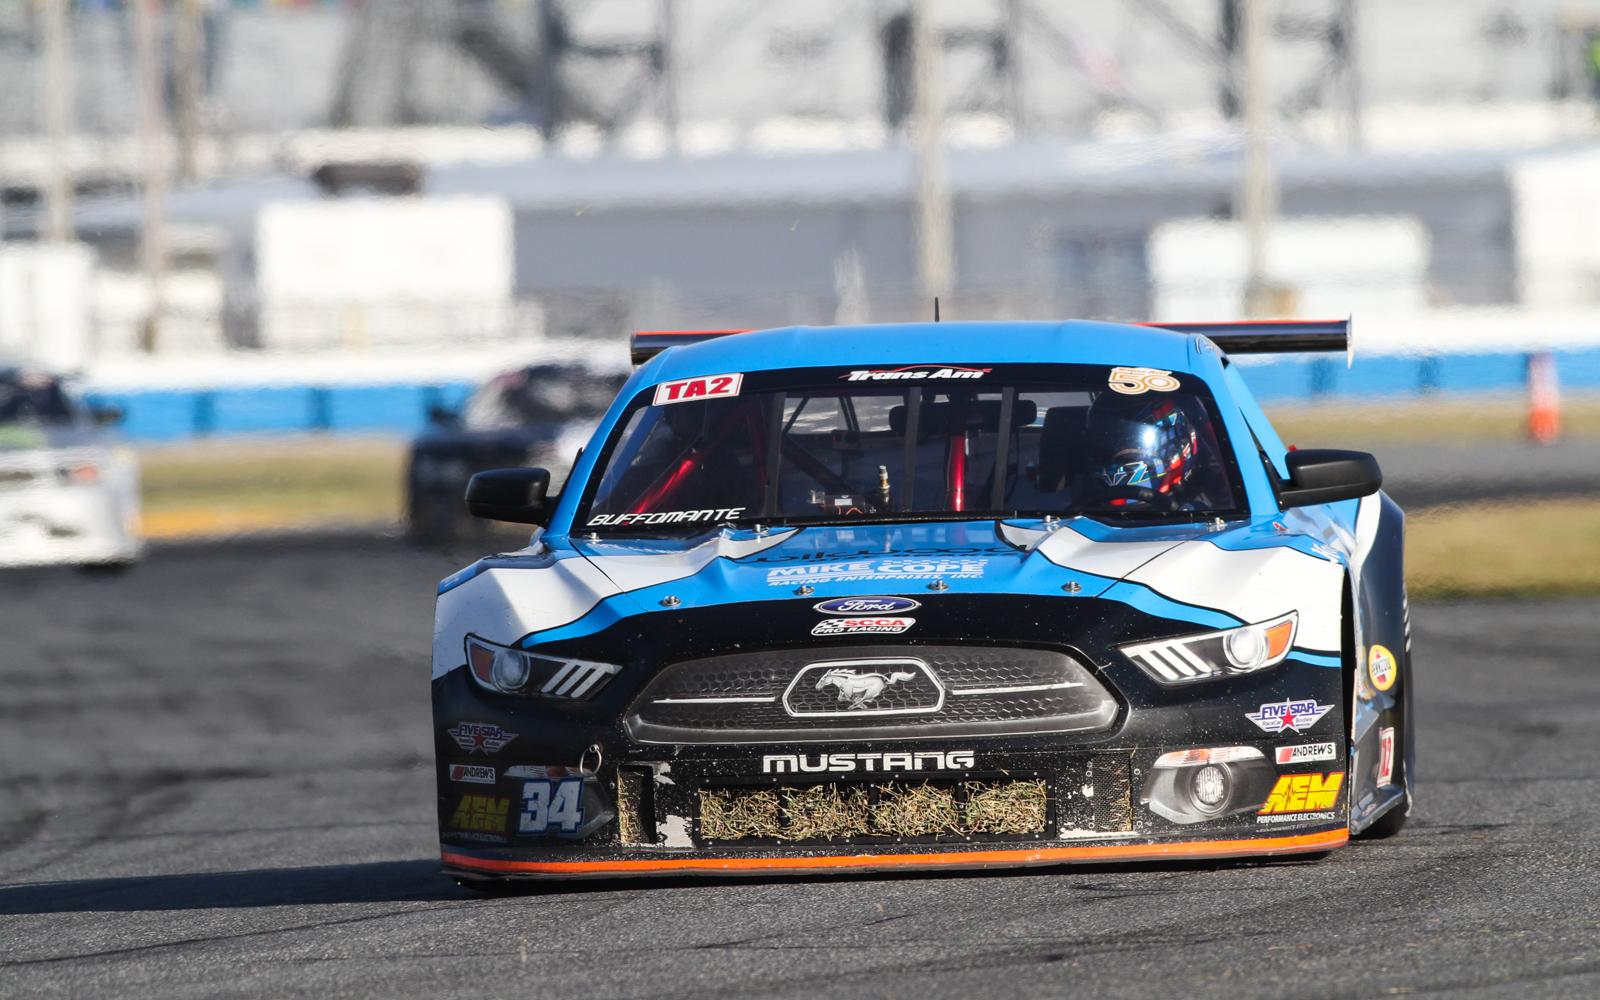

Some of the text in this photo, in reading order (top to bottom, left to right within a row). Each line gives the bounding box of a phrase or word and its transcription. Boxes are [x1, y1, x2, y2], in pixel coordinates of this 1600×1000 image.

[848, 369, 985, 381] Trans Am
[1108, 368, 1181, 395] 50
[665, 377, 733, 401] TA2
[586, 507, 747, 527] BUFFOMANTE
[768, 562, 985, 577] MIKE COPE
[768, 578, 830, 586] RACING
[838, 599, 894, 613] Ford
[814, 625, 905, 635] PRO RACING
[843, 618, 906, 627] SCCA
[1262, 702, 1316, 719] FIVE STAR
[459, 724, 480, 738] FIVE
[763, 750, 975, 773] MUSTANG
[1258, 772, 1344, 813] AEM
[519, 777, 584, 833] 34
[1257, 811, 1336, 823] PERFORMANCE ELECTRONICS
